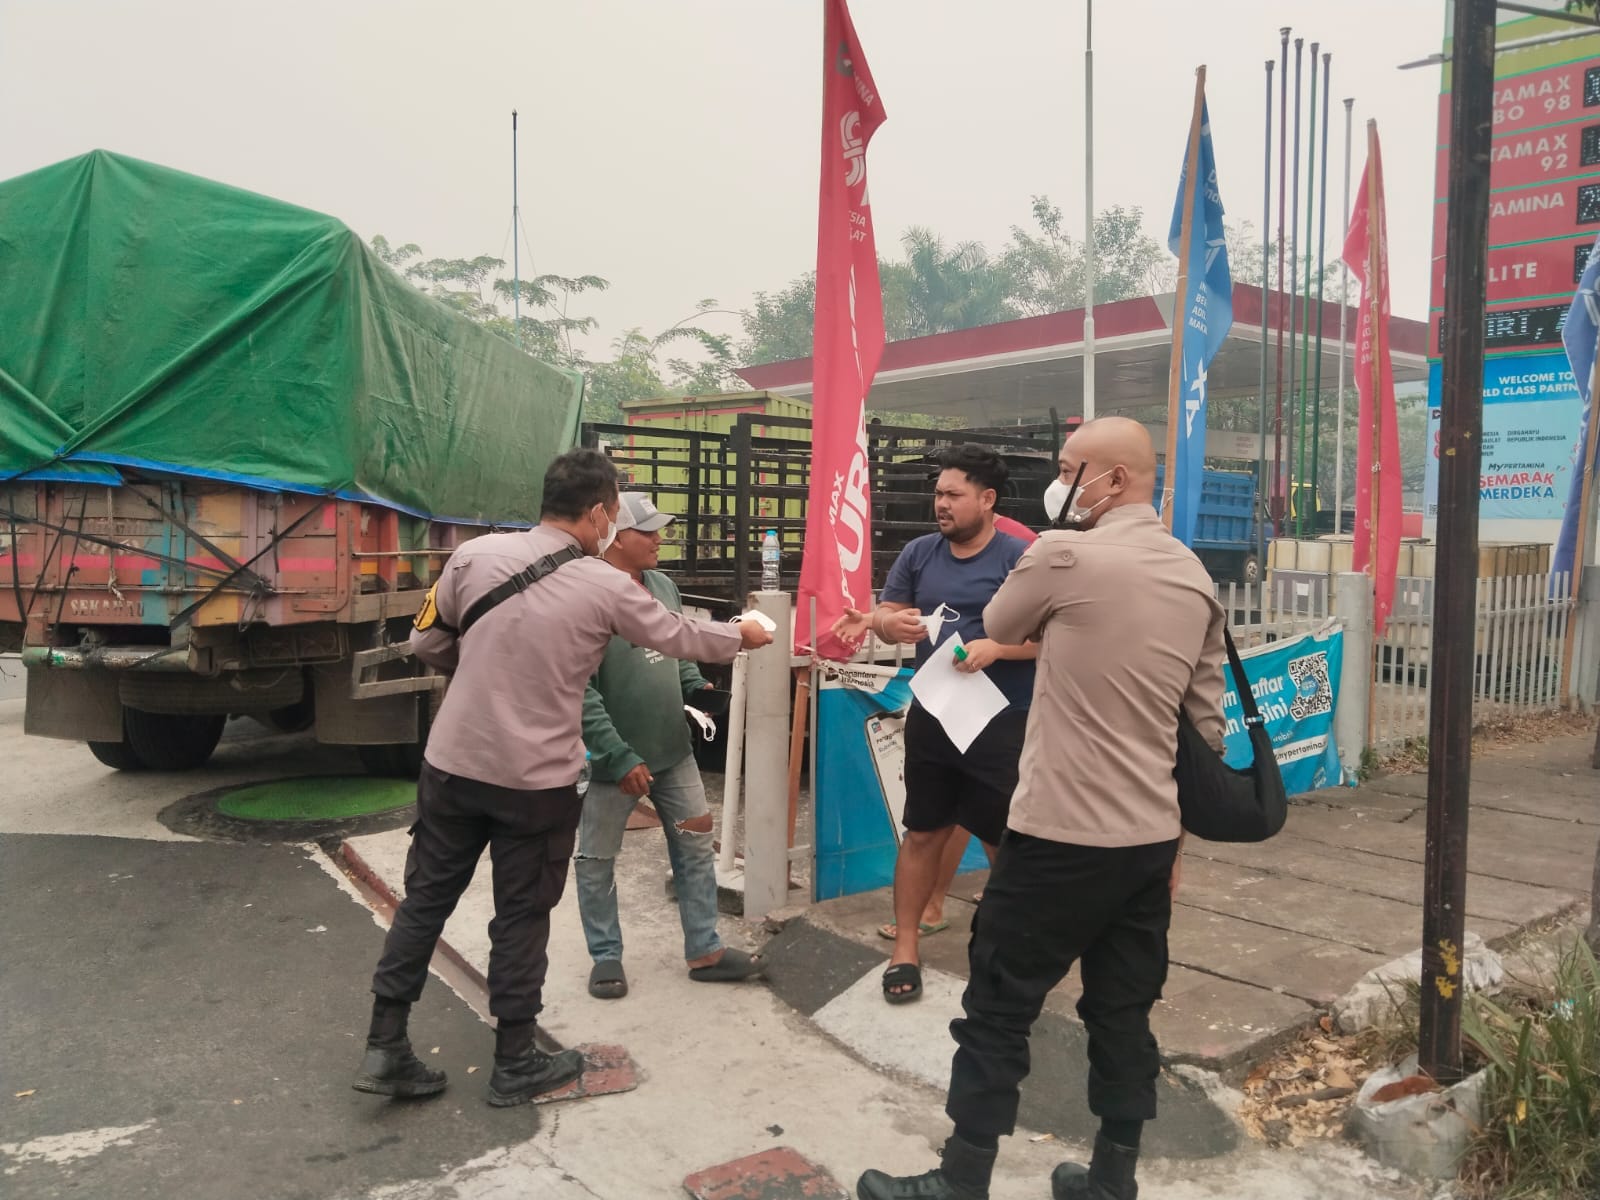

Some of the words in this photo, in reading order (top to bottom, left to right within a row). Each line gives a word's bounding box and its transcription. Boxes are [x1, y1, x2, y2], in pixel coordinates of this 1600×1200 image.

[1543, 95, 1571, 113] 98
[1540, 153, 1568, 172] 92
[1489, 192, 1565, 218] AMINA
[1488, 262, 1537, 282] LITE
[1498, 372, 1556, 386] WELCOME
[1558, 372, 1574, 381] TO
[1502, 385, 1537, 396] CLASS
[1480, 471, 1555, 489] SEMARAK
[1480, 486, 1555, 500] MERDEKA
